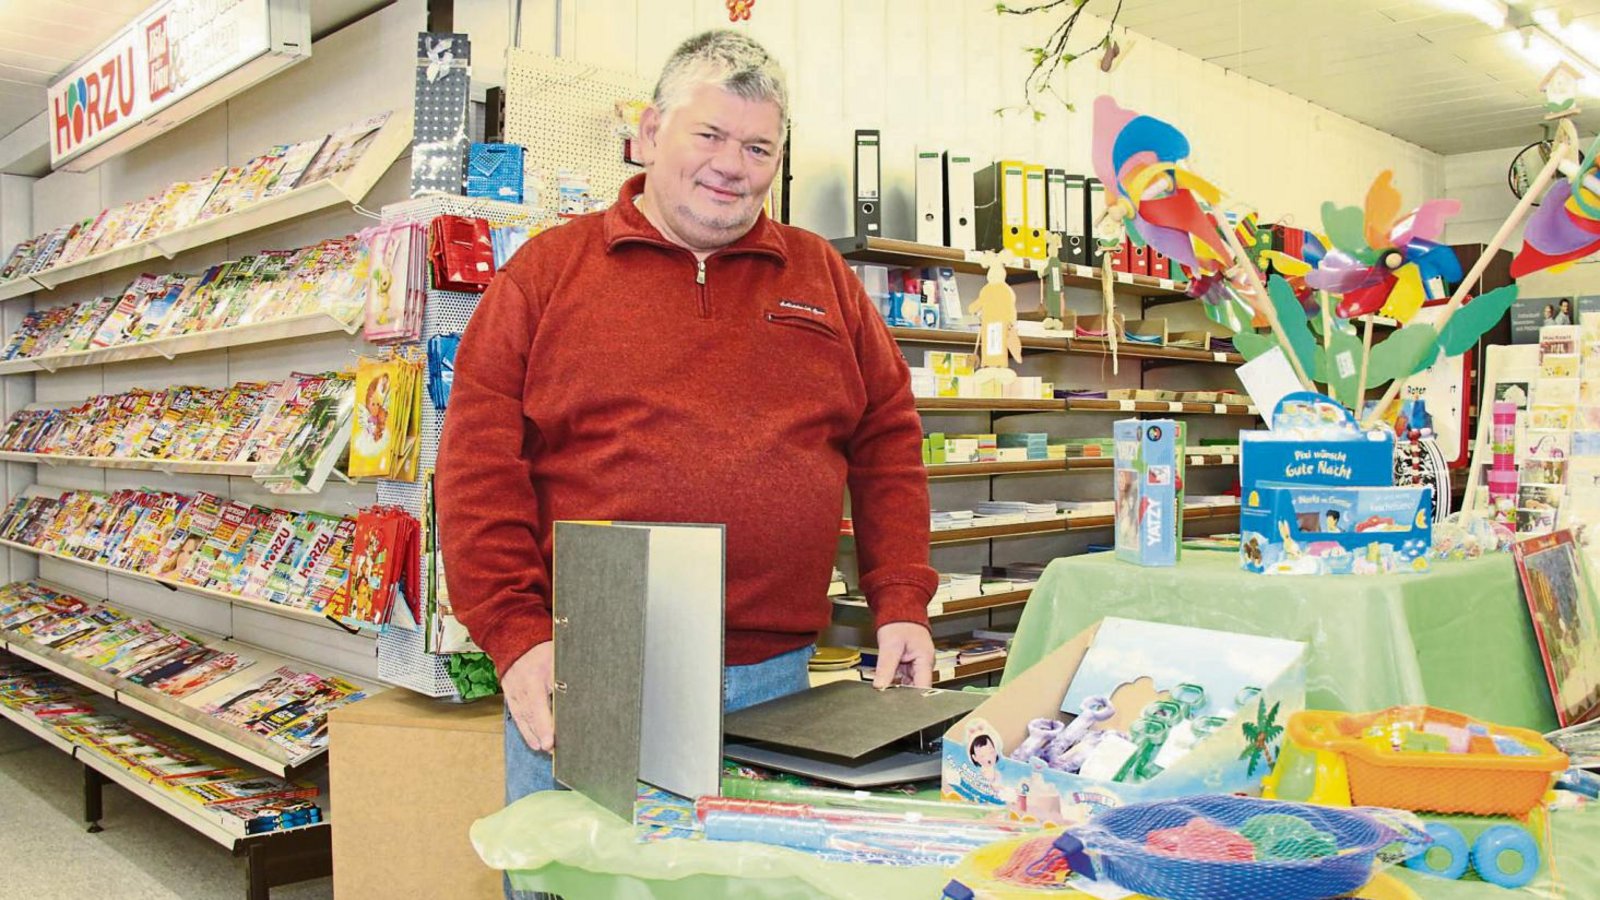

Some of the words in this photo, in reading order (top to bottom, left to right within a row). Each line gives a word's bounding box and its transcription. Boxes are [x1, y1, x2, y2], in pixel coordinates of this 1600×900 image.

[1294, 449, 1311, 461] Pixi
[1313, 449, 1347, 462] wünscht
[1286, 463, 1314, 477] Gute
[1317, 460, 1352, 479] Nacht
[1146, 497, 1162, 547] YATZY
